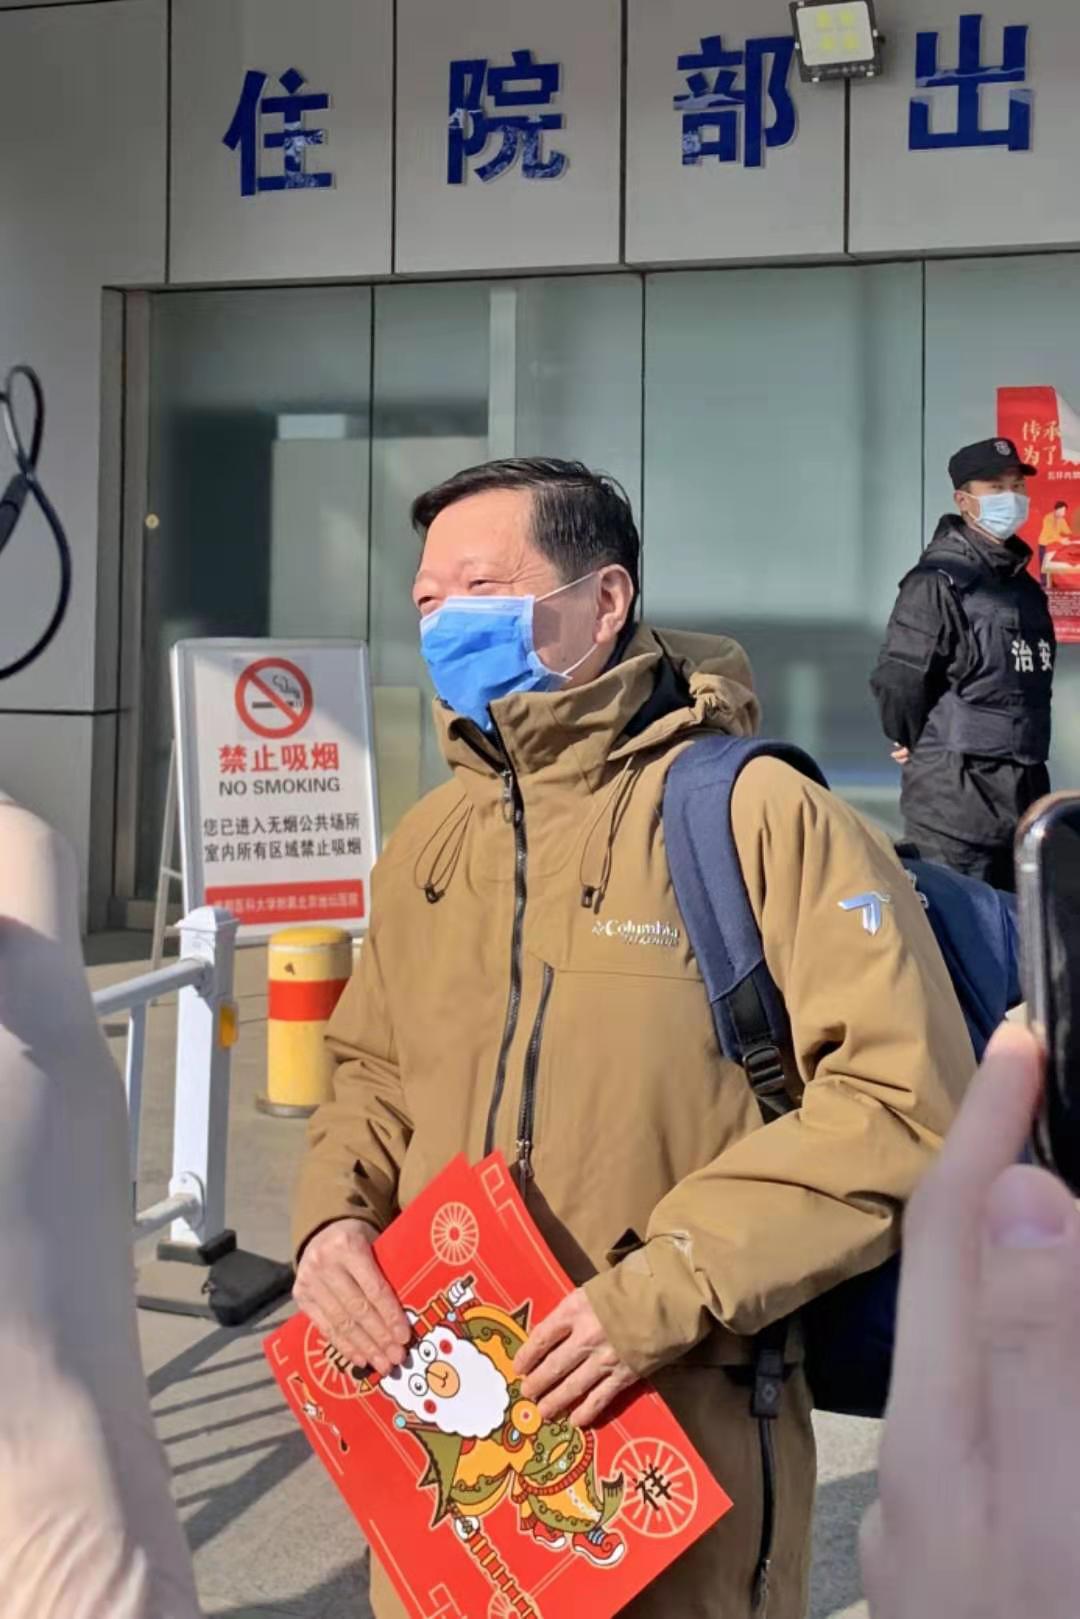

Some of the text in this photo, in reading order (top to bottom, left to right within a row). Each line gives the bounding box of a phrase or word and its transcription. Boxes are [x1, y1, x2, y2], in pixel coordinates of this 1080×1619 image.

[222, 14, 1034, 197] 住院部出
[1011, 639, 1052, 673] 治安
[218, 742, 340, 774] 禁止吸烟
[219, 776, 340, 796] NO SMOKING
[204, 812, 360, 837] 您已进入无烟公共场所
[204, 837, 362, 862] 室内所有区域禁止吸烟
[605, 919, 679, 937] Columbia
